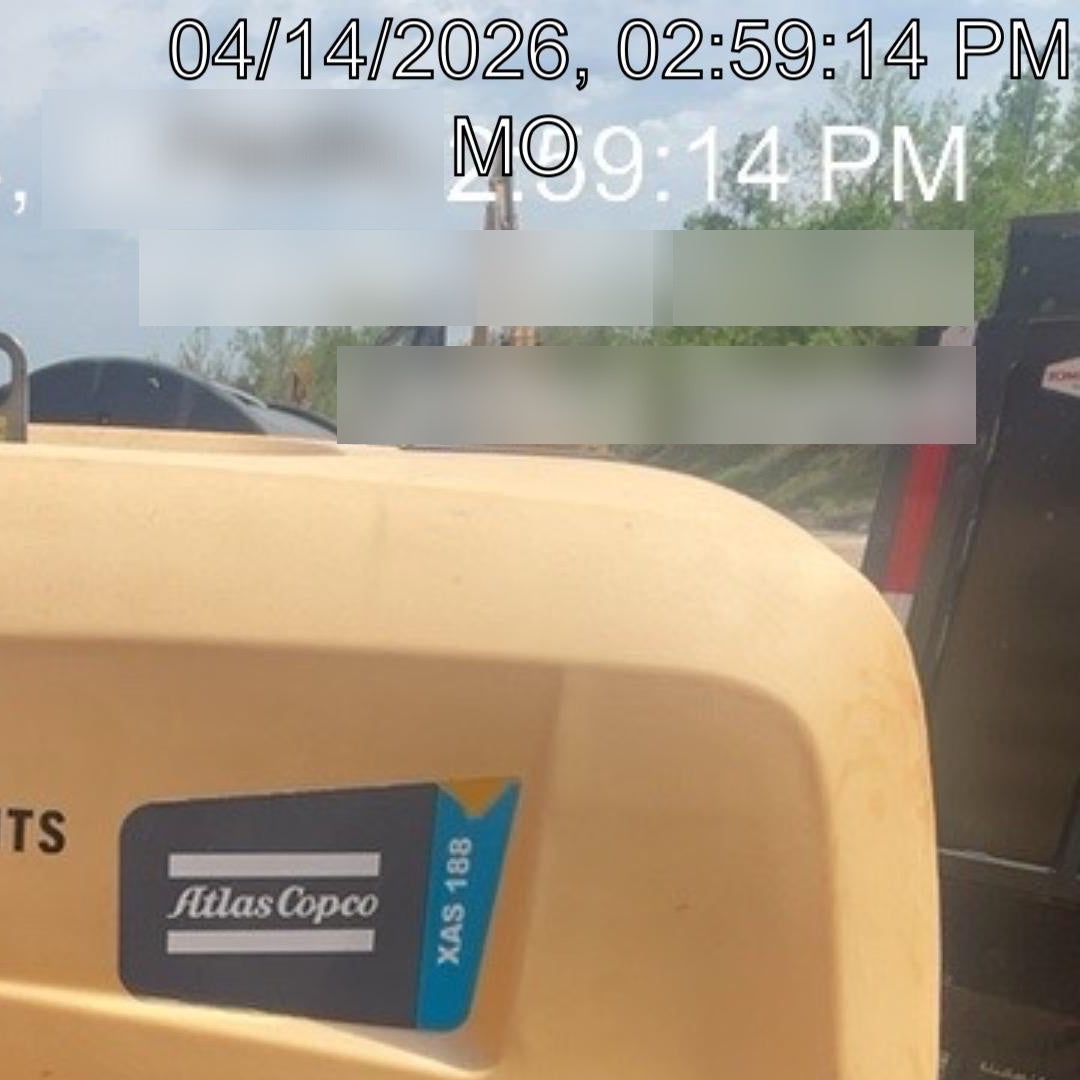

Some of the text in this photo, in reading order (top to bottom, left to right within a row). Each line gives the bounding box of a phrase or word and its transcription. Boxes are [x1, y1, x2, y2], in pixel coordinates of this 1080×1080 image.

[166, 884, 379, 924] Atlas Copco
[436, 836, 473, 966] XAS 188
